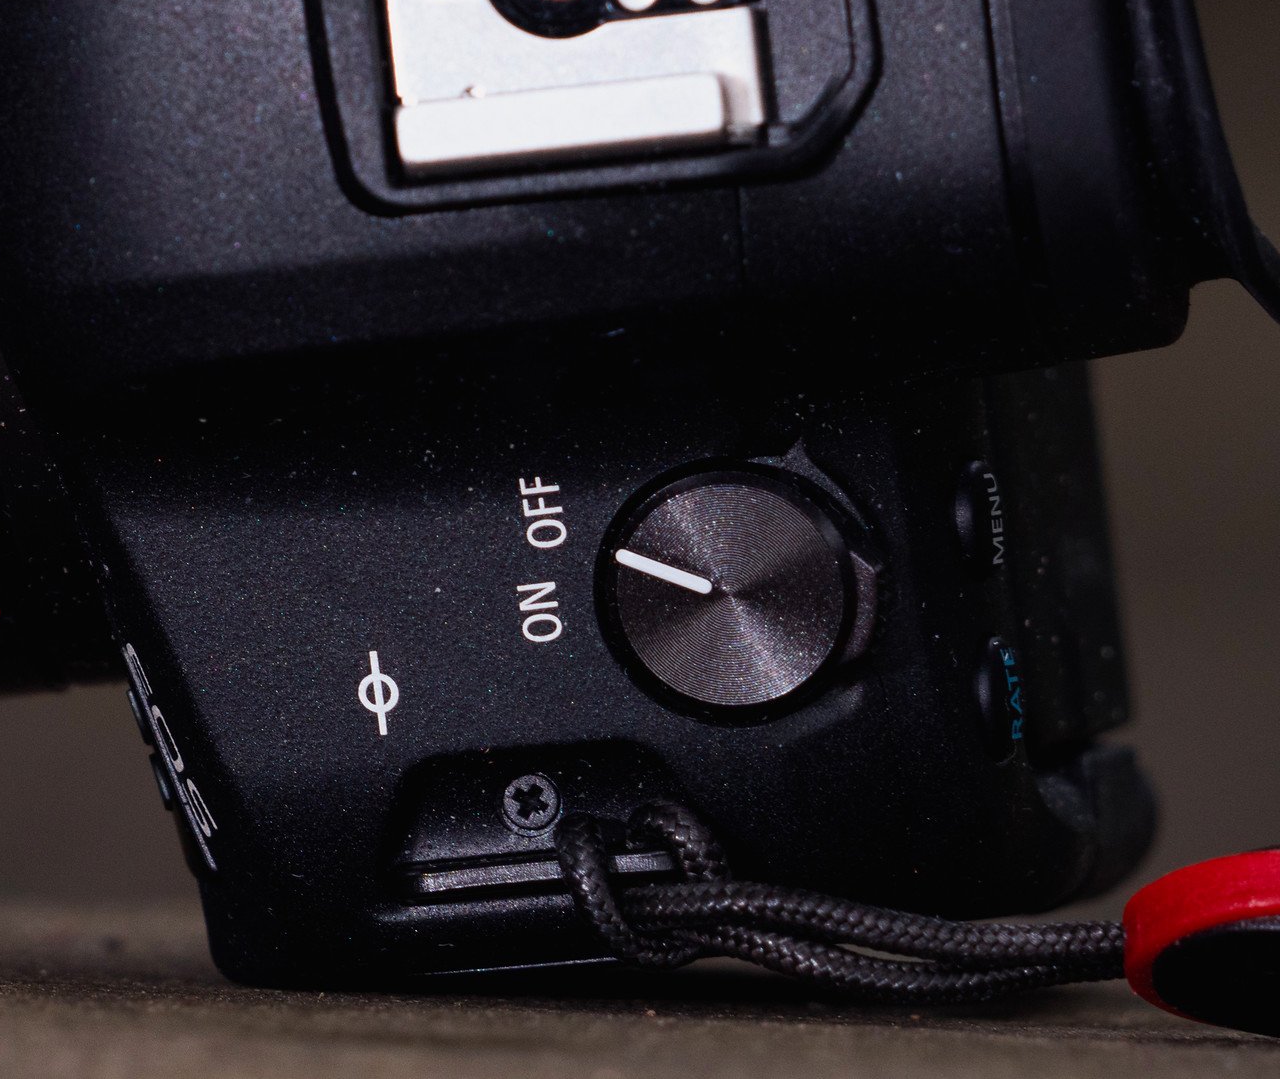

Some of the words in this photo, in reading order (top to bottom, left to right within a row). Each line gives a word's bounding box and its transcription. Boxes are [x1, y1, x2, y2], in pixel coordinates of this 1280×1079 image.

[518, 476, 568, 549] OFF
[983, 472, 1007, 565] MENU
[516, 581, 563, 643] ON
[999, 647, 1024, 740] RATE
